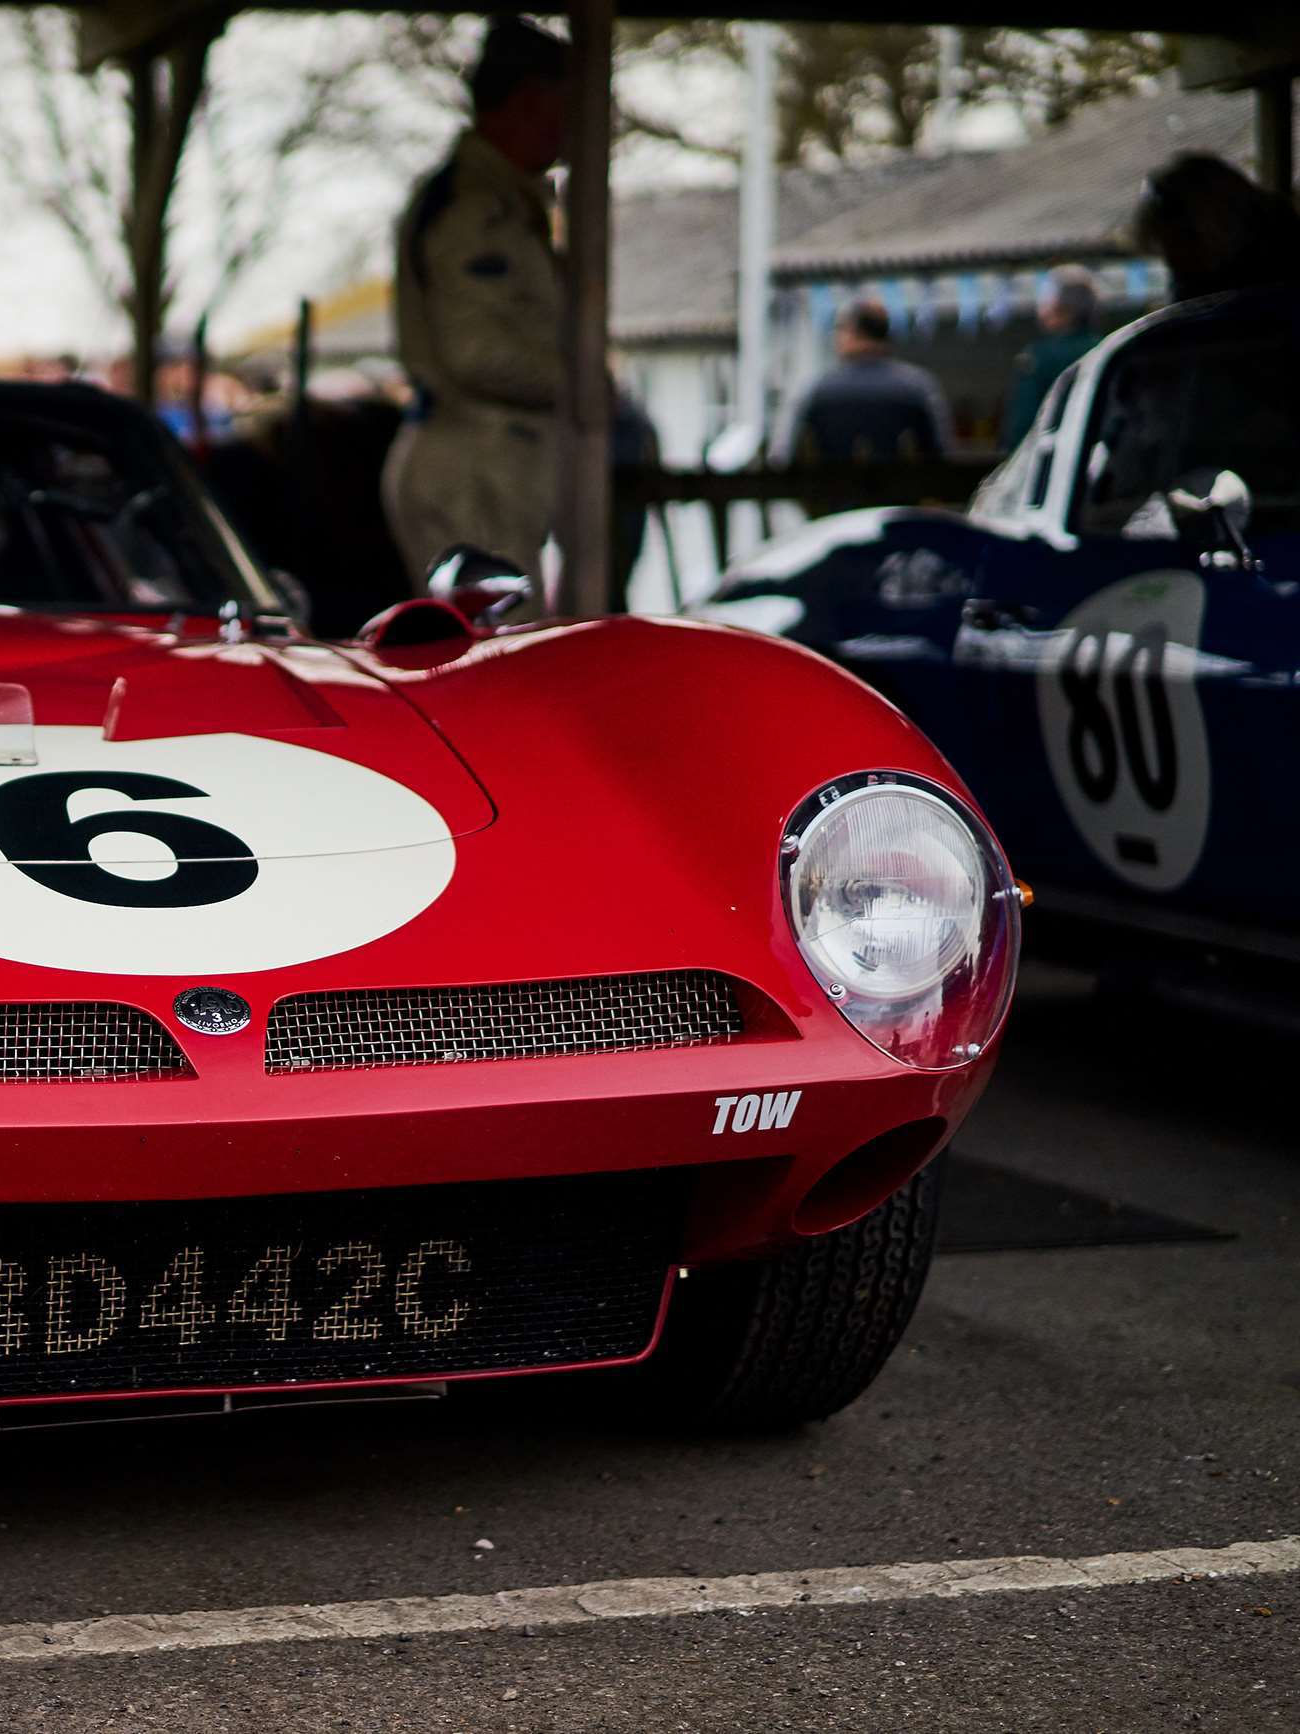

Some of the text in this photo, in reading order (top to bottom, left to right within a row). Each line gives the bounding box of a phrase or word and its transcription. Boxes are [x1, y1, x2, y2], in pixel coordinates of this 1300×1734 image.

[1058, 620, 1178, 814] 80
[197, 1018, 238, 1028] LIVORNO
[712, 1090, 803, 1135] TOW
